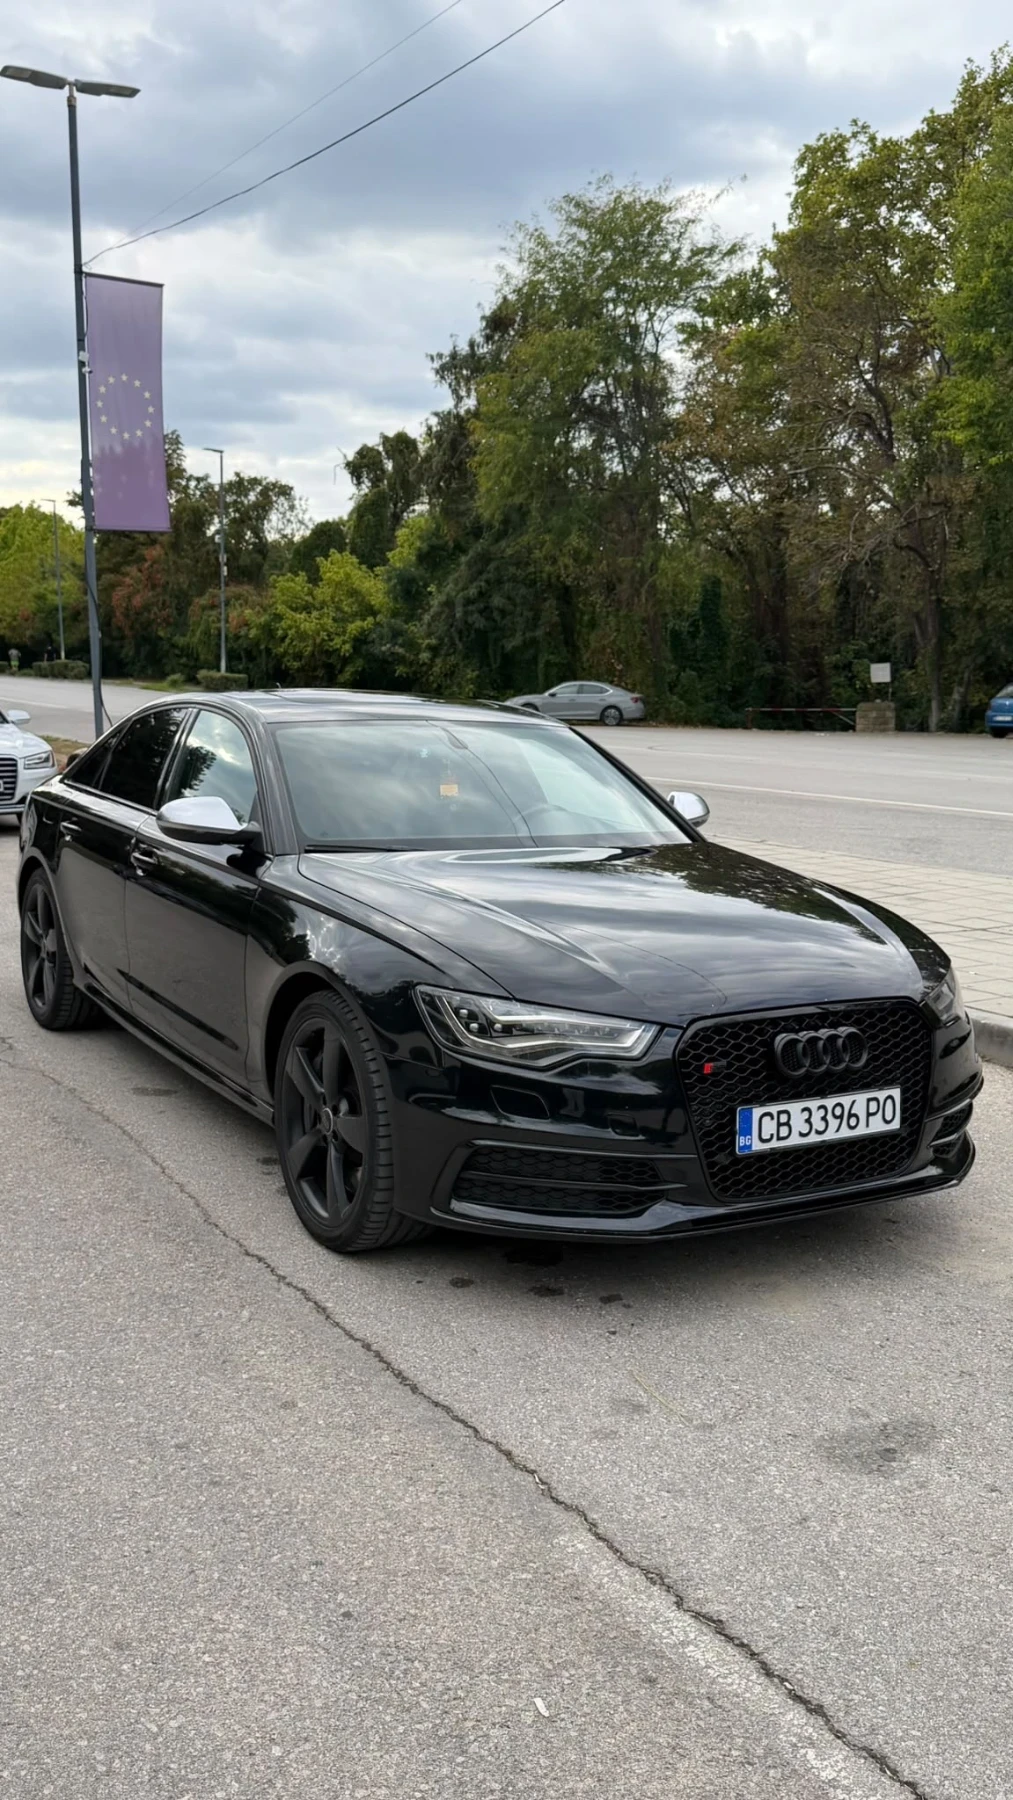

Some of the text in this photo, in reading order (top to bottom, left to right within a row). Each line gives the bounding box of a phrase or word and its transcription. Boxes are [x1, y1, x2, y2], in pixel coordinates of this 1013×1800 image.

[757, 1109, 793, 1144] CB
[798, 1099, 860, 1138] 3396
[739, 1136, 752, 1146] BG
